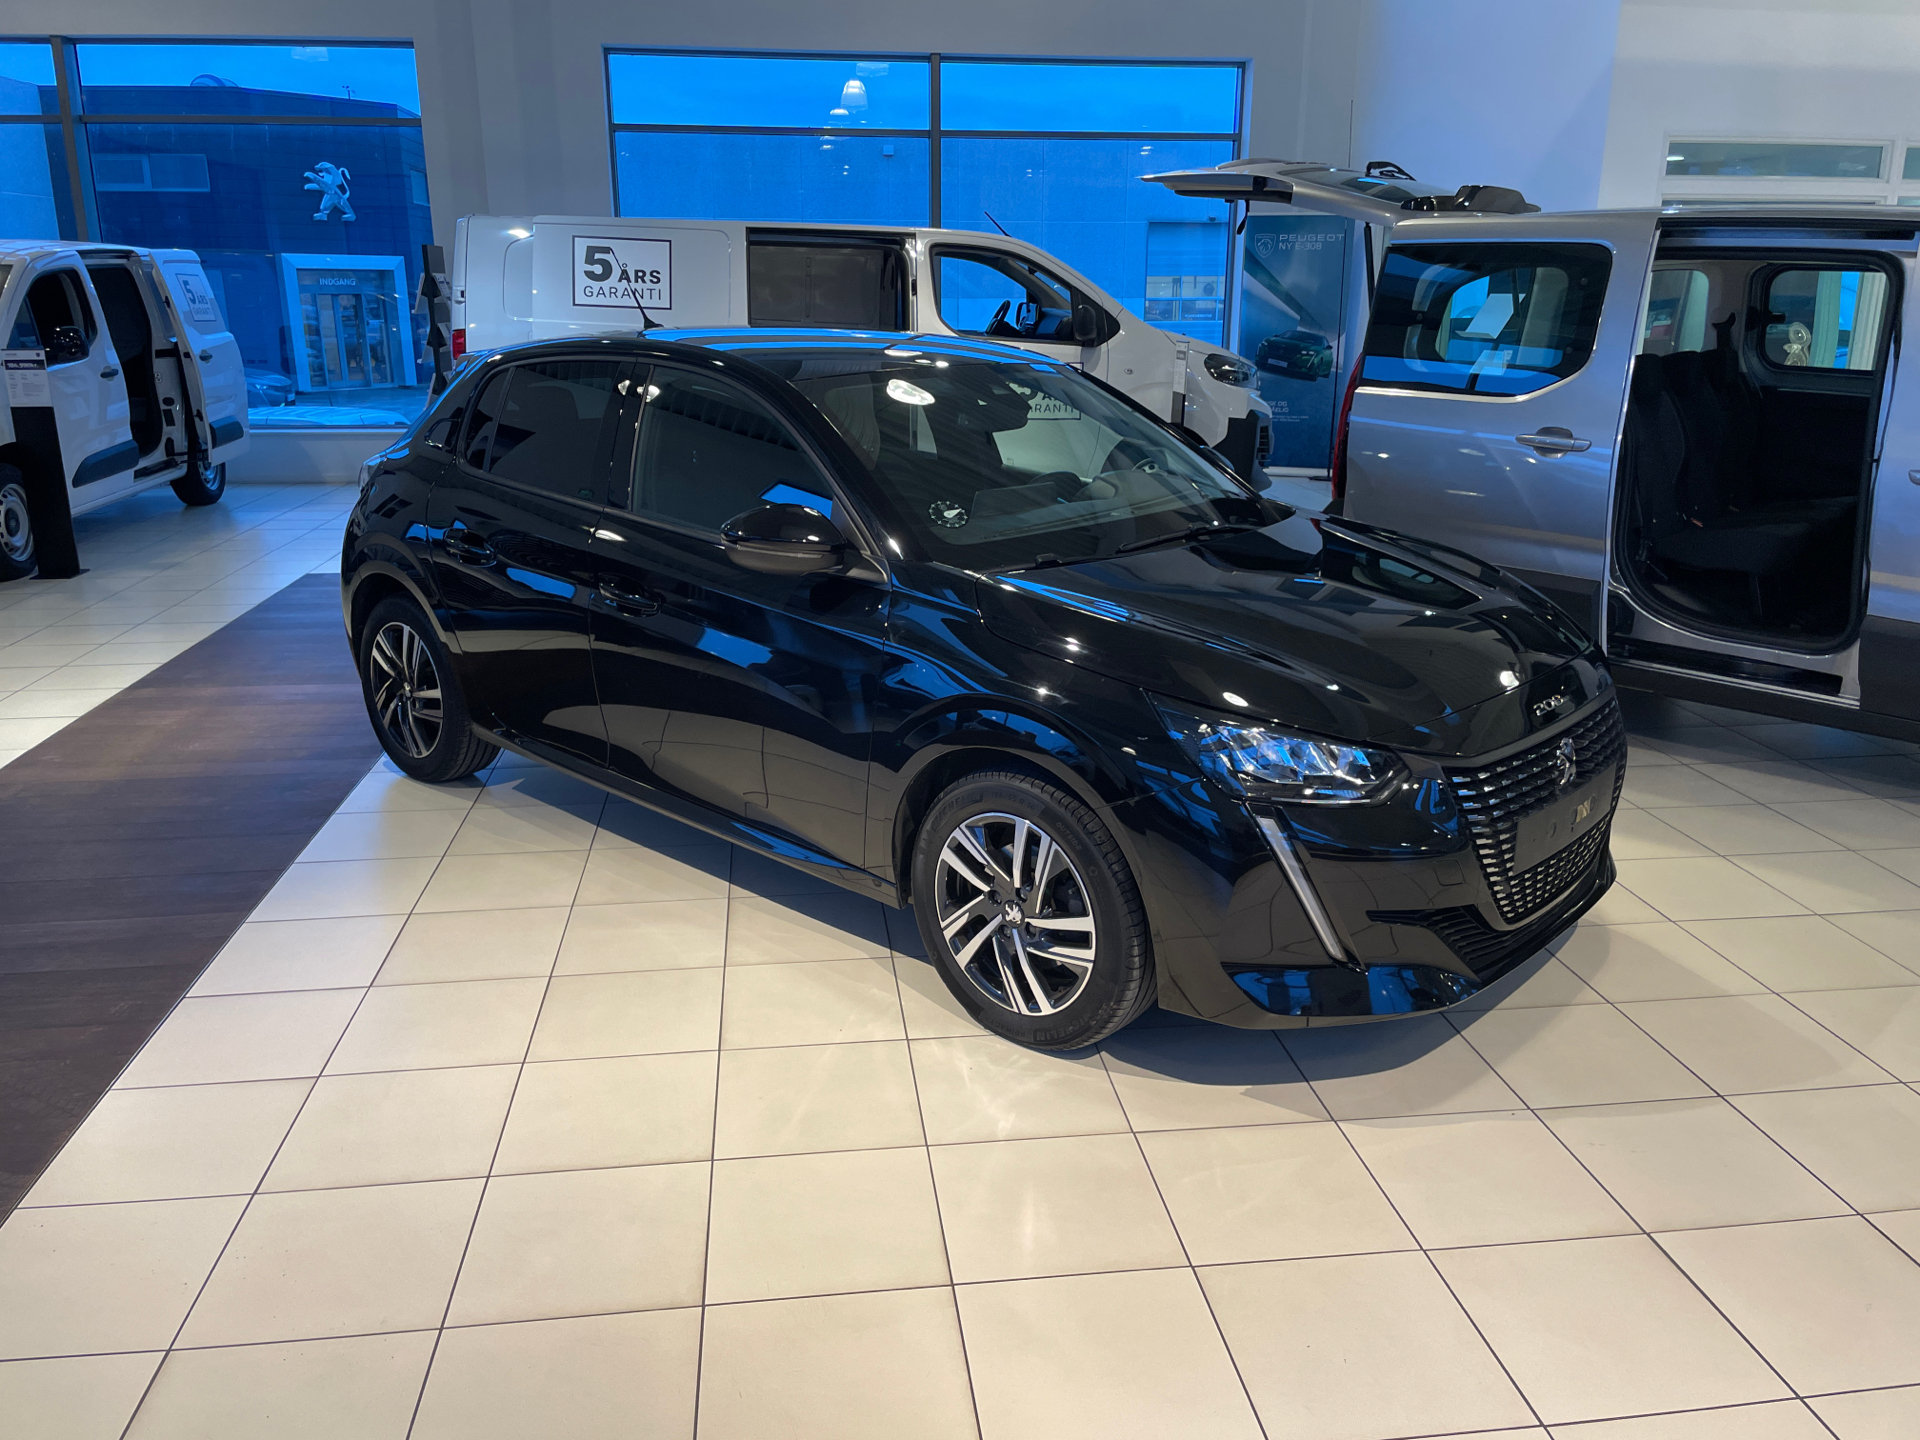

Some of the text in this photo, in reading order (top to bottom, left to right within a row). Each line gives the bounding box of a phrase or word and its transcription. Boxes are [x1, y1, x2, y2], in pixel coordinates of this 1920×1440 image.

[1279, 233, 1345, 242] PEUGEOT
[1278, 242, 1323, 251] NY E-308
[583, 245, 662, 285] 5 ÅRS
[319, 277, 356, 286] INDGANG
[182, 279, 197, 305] 5
[583, 285, 662, 301] GARANTI
[1533, 694, 1564, 716] 208
